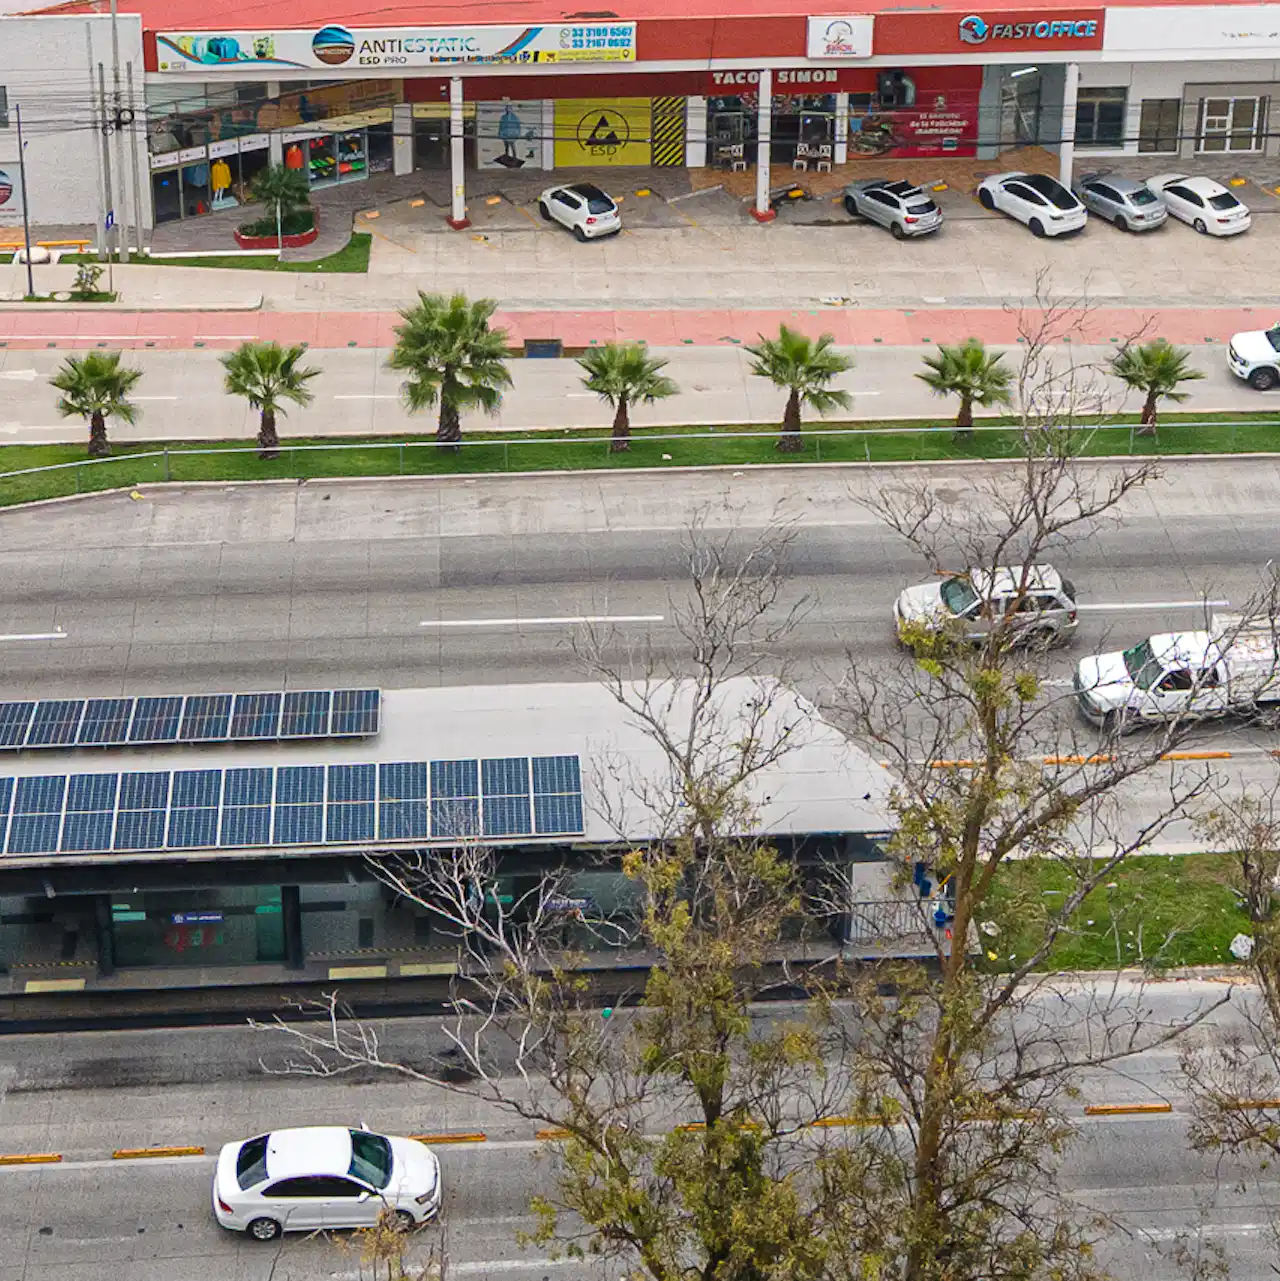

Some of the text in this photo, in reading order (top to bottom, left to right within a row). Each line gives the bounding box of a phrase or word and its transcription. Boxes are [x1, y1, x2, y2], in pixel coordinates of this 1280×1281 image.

[991, 20, 1098, 39] FASTOFFICE
[359, 56, 407, 65] ESD PRO
[713, 69, 838, 84] TACO SIMON
[590, 145, 617, 157] ESD
